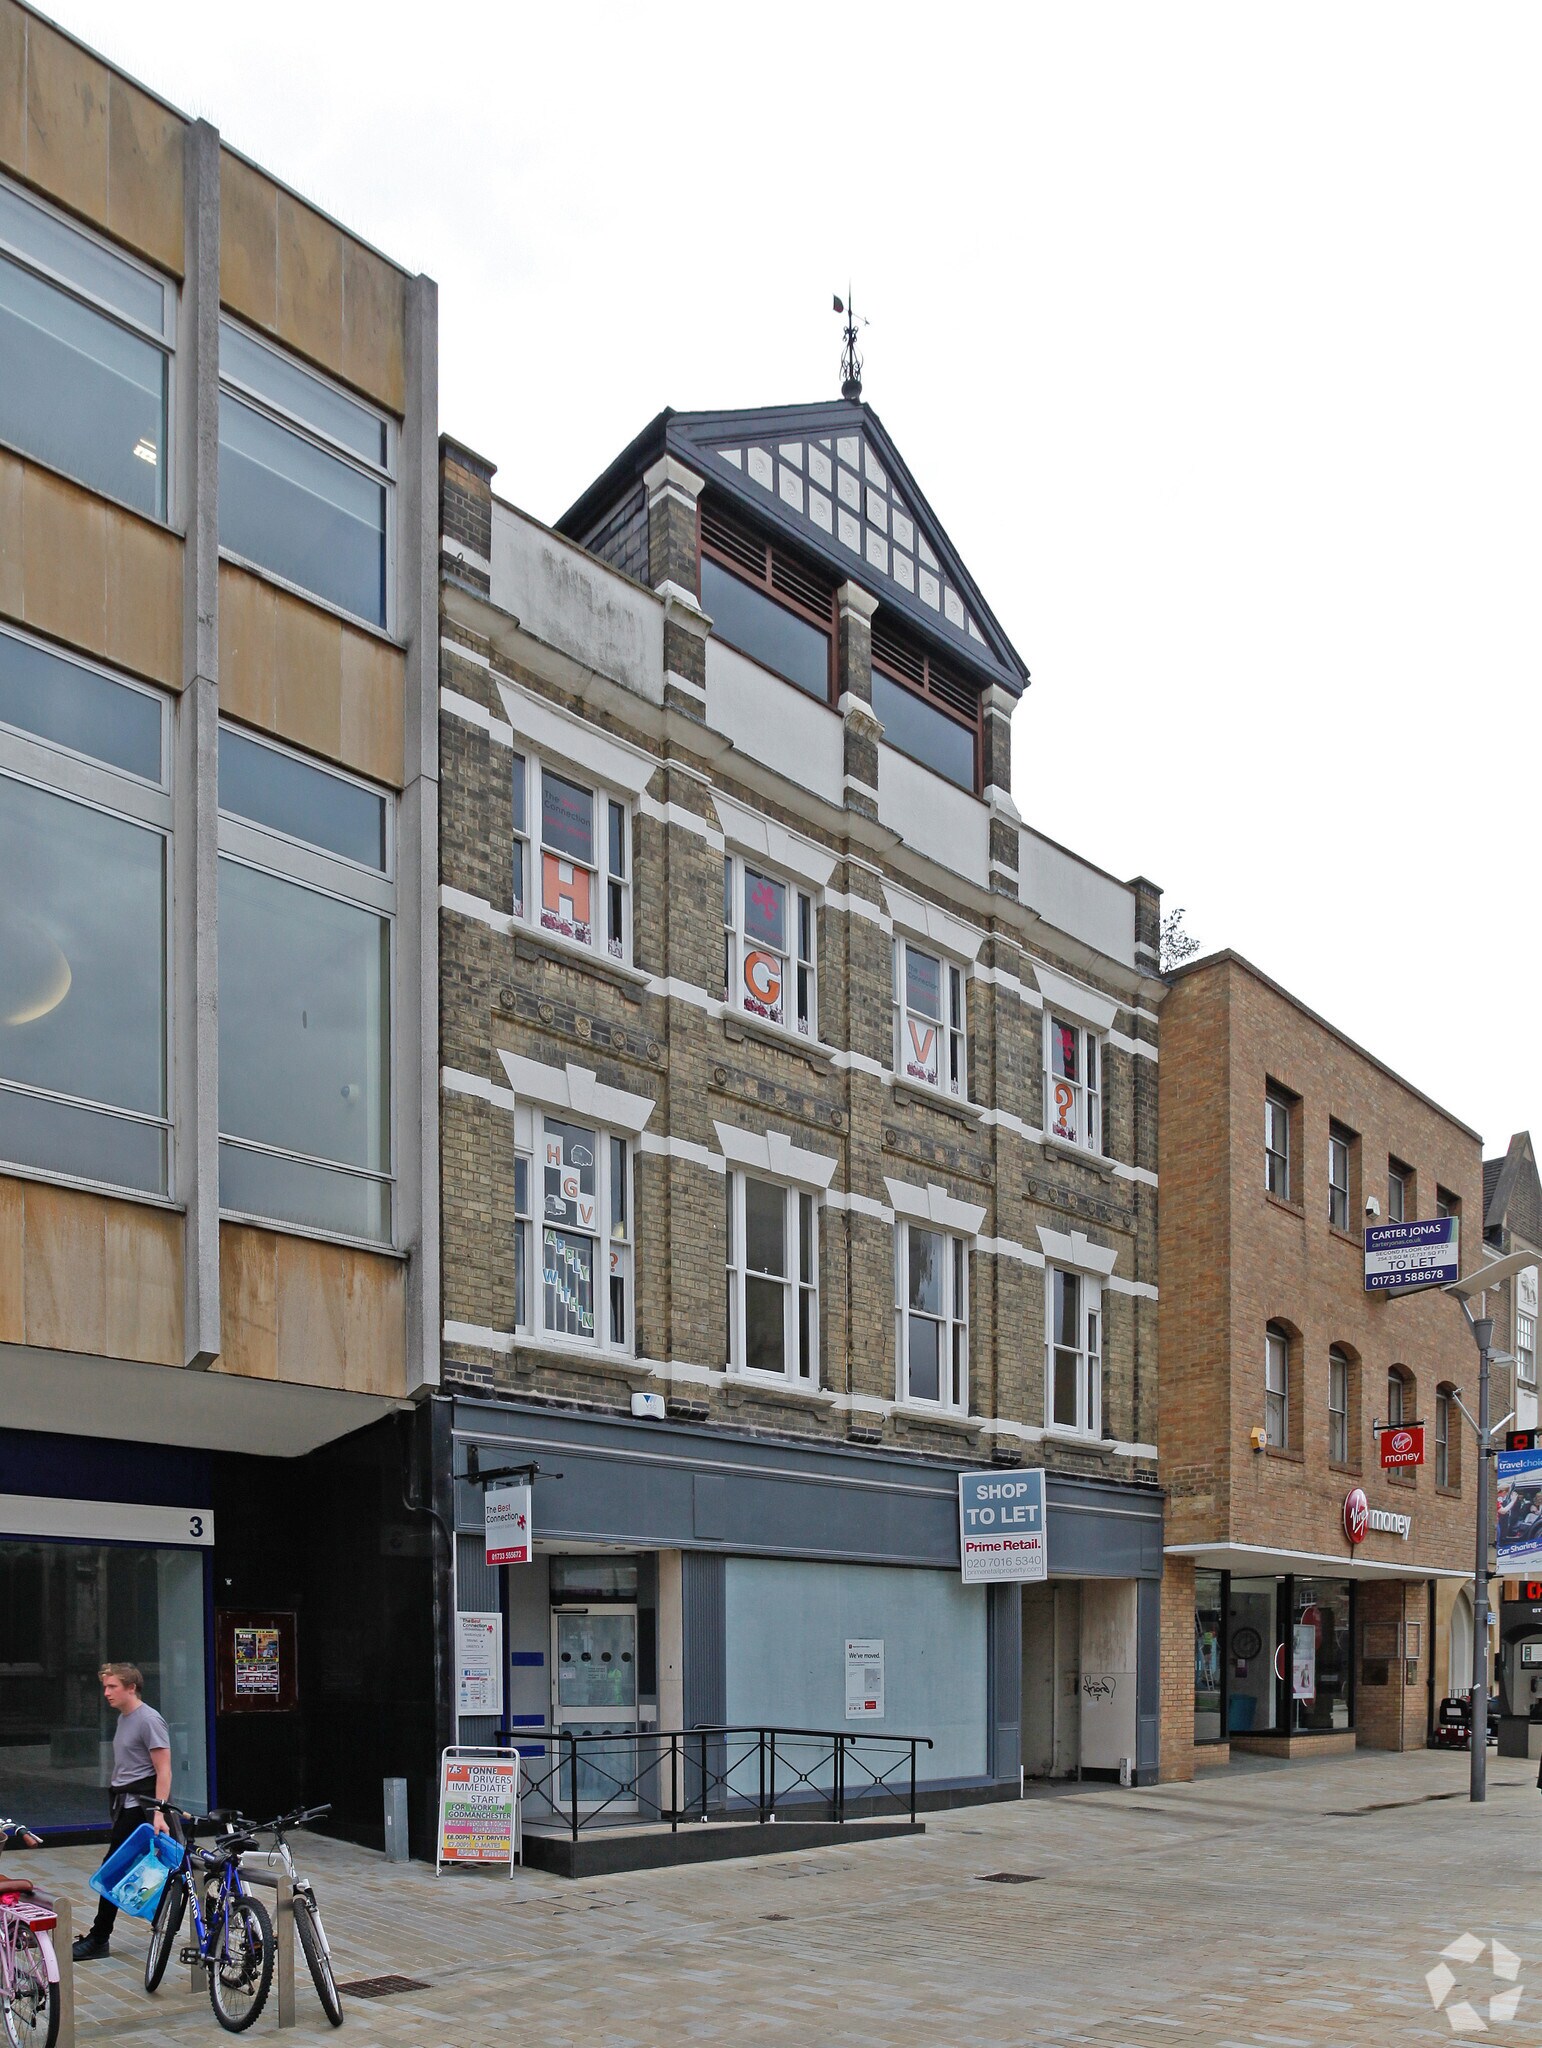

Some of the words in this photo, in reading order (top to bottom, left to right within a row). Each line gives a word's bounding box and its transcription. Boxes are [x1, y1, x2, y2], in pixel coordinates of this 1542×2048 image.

[544, 800, 591, 826] Connection
[1371, 1229, 1407, 1240] CARTER
[1408, 1224, 1441, 1237] JONAS
[1371, 1237, 1422, 1248] carterjonas.co.uk
[1376, 1249, 1400, 1257] SECOND
[1388, 1259, 1406, 1270] TO
[1411, 1256, 1436, 1268] LET
[1371, 1275, 1402, 1286] 01733
[1404, 1269, 1444, 1282] 588678
[1385, 1452, 1420, 1463] money
[976, 1482, 1028, 1500] SHOP
[486, 1505, 497, 1515] The
[497, 1503, 511, 1513] Best
[966, 1507, 995, 1525] TO
[1001, 1504, 1038, 1523] LET
[486, 1512, 518, 1523] Connection
[190, 1515, 204, 1537] 3
[1369, 1509, 1412, 1540] money
[966, 1541, 1001, 1552] Prime
[1003, 1538, 1041, 1550] Retail.
[1497, 1548, 1510, 1556] Car
[966, 1559, 986, 1568] 020
[988, 1556, 1012, 1567] 7016
[1015, 1555, 1041, 1566] 5340
[966, 1566, 1041, 1576] primeretailproperty.com
[448, 1766, 462, 1774] 7.5
[467, 1766, 497, 1775] TONNE
[473, 1775, 511, 1785] DRIVERS
[452, 1783, 507, 1793] IMMEDIATE
[471, 1794, 500, 1804] START
[448, 1811, 511, 1819] GODMANCHESTER
